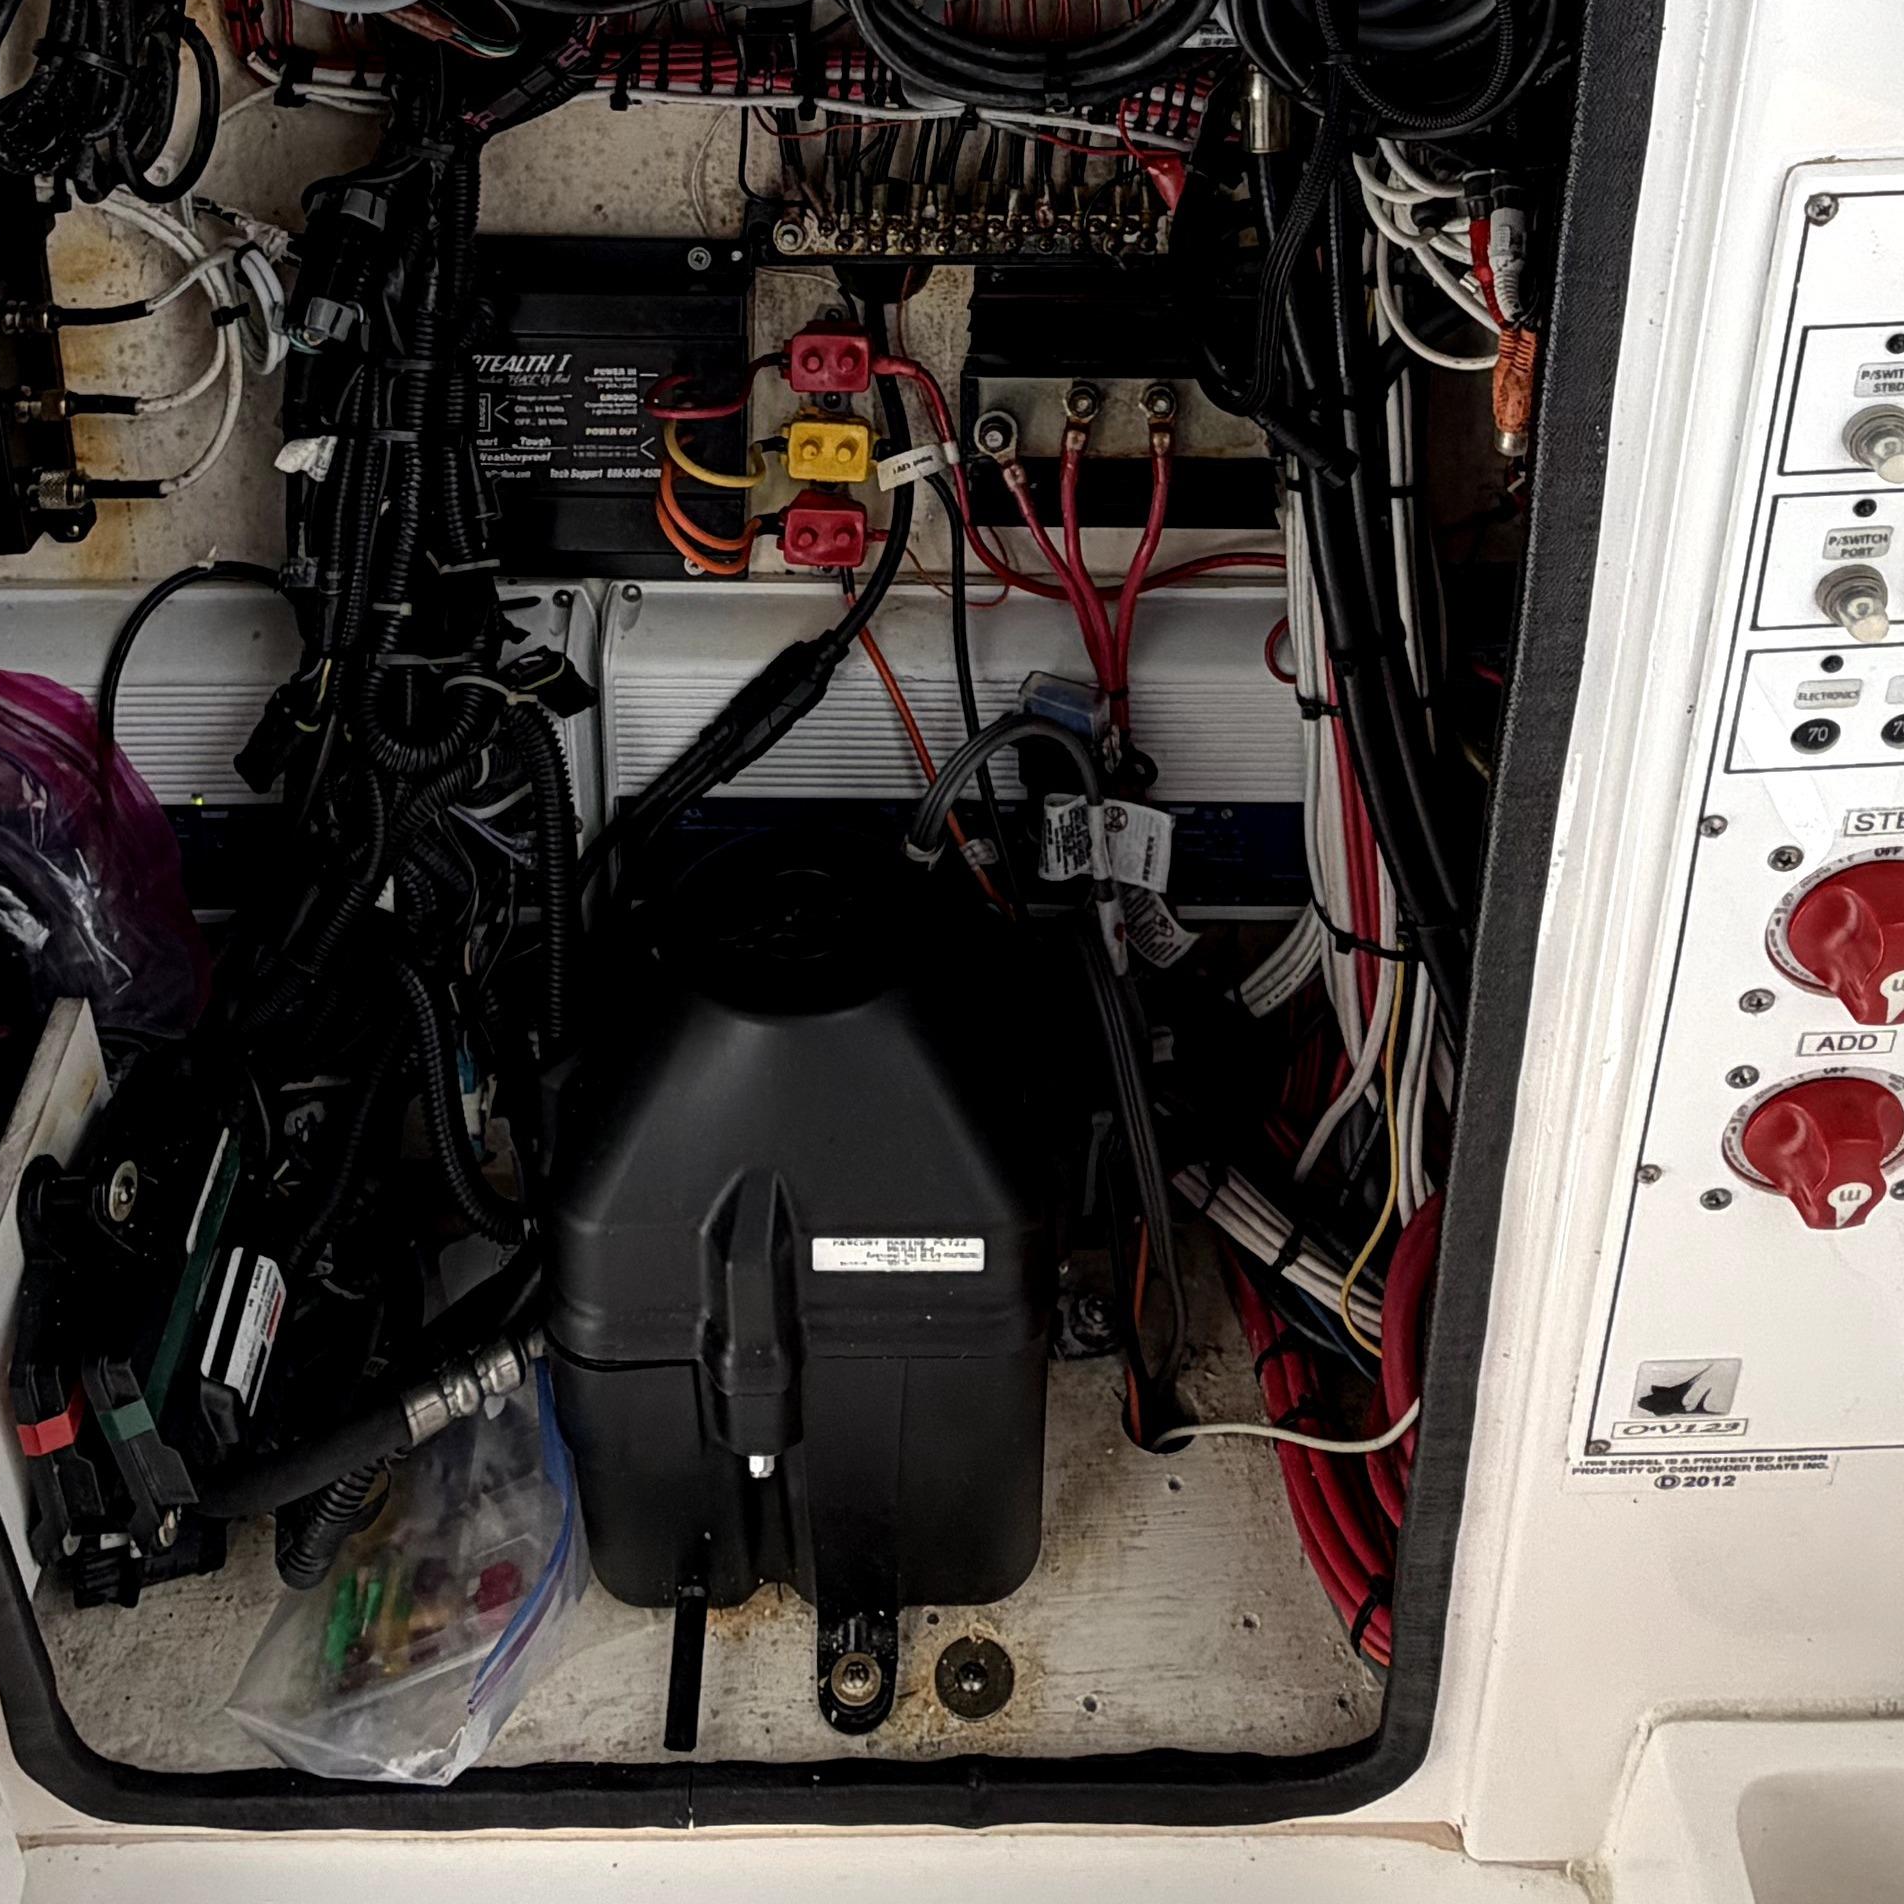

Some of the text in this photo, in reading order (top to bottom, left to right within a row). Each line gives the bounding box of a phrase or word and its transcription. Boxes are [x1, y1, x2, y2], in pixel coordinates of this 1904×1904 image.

[593, 367, 626, 376] POWER
[584, 427, 639, 436] POWER OUT
[550, 468, 570, 478] Tech
[570, 468, 603, 480] Support
[1828, 533, 1888, 546] P/SWITCH
[1840, 547, 1874, 559] PORT
[1798, 690, 1860, 702] ELECTRONICS
[1807, 726, 1829, 743] 70
[1874, 847, 1903, 857] OFF
[1815, 1034, 1879, 1052] ADD
[1611, 1459, 1661, 1467] VESSEL
[1693, 1456, 1774, 1466] PROTECTED
[1777, 1454, 1829, 1463] DESIGN
[1572, 1462, 1830, 1475] PROPERTY OF CONTENDER BOATS INC.
[1682, 1475, 1737, 1488] 2012
